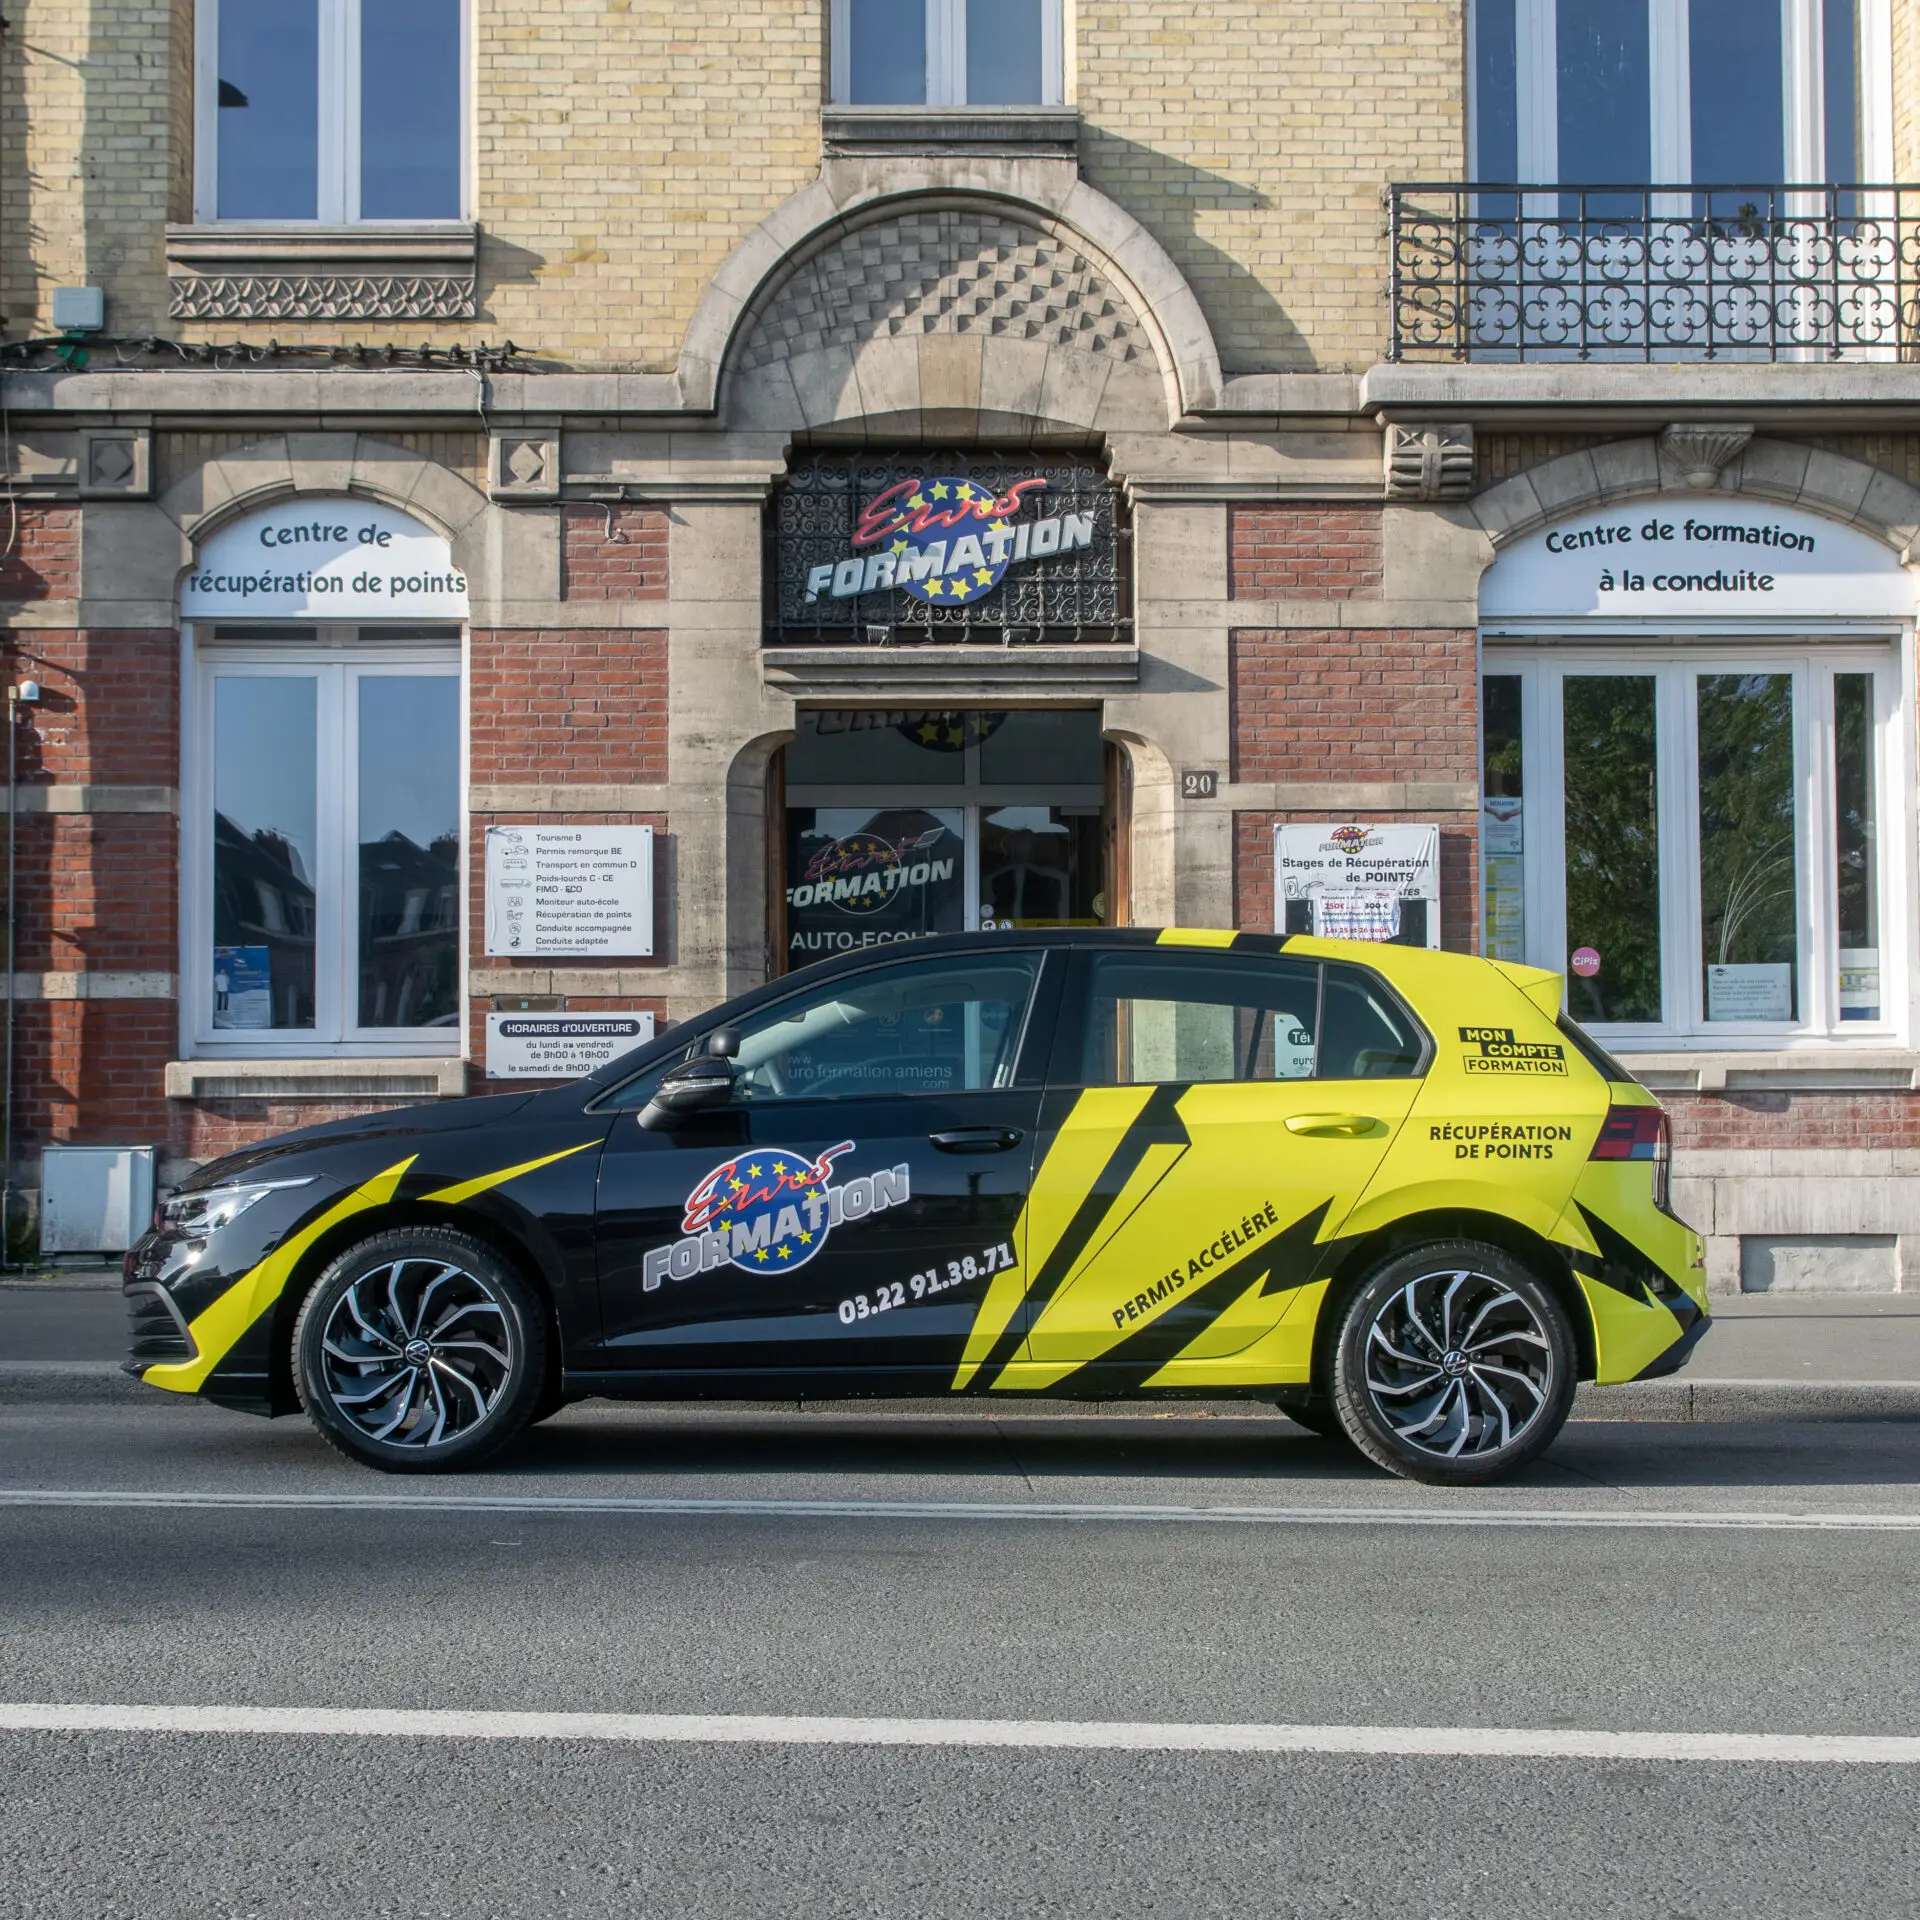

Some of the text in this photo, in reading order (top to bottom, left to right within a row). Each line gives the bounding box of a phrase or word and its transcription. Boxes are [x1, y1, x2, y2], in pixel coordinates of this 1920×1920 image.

[260, 522, 392, 548] Centre de
[1545, 519, 1815, 554] Centre de formation
[804, 511, 1095, 604] FORMATION
[190, 570, 466, 597] récupération de points
[1599, 569, 1775, 592] à la conduite
[1184, 775, 1212, 794] 20
[568, 849, 608, 857] remorque
[536, 861, 578, 870] Transport
[1282, 858, 1429, 870] Stages de Récupération
[1346, 872, 1414, 882] de POINTS
[536, 911, 591, 919] Récupération
[606, 911, 632, 919] points
[575, 925, 632, 933] accompagnée
[575, 937, 608, 946] adaptée
[790, 931, 938, 949] AUTO-ECO
[507, 1023, 632, 1033] HORAIRES d'OUVERTURE
[1467, 1029, 1507, 1042] MON
[531, 1051, 541, 1059] de
[543, 1051, 568, 1059] 9h00
[1488, 1042, 1557, 1058] COMPTE
[508, 1064, 516, 1072] le
[518, 1064, 550, 1072] samedi
[817, 1064, 892, 1079] formation
[895, 1064, 952, 1078] amiens
[1468, 1059, 1564, 1073] FORMATION
[1430, 1122, 1572, 1141] RÉCUPÉRATION
[1455, 1145, 1553, 1159] DE POINTS
[643, 1163, 910, 1292] FORMATION
[1112, 1200, 1279, 1329] PERMIS ACCÉLÉRÉ
[838, 1243, 1014, 1324] 03.22 91.38.71
